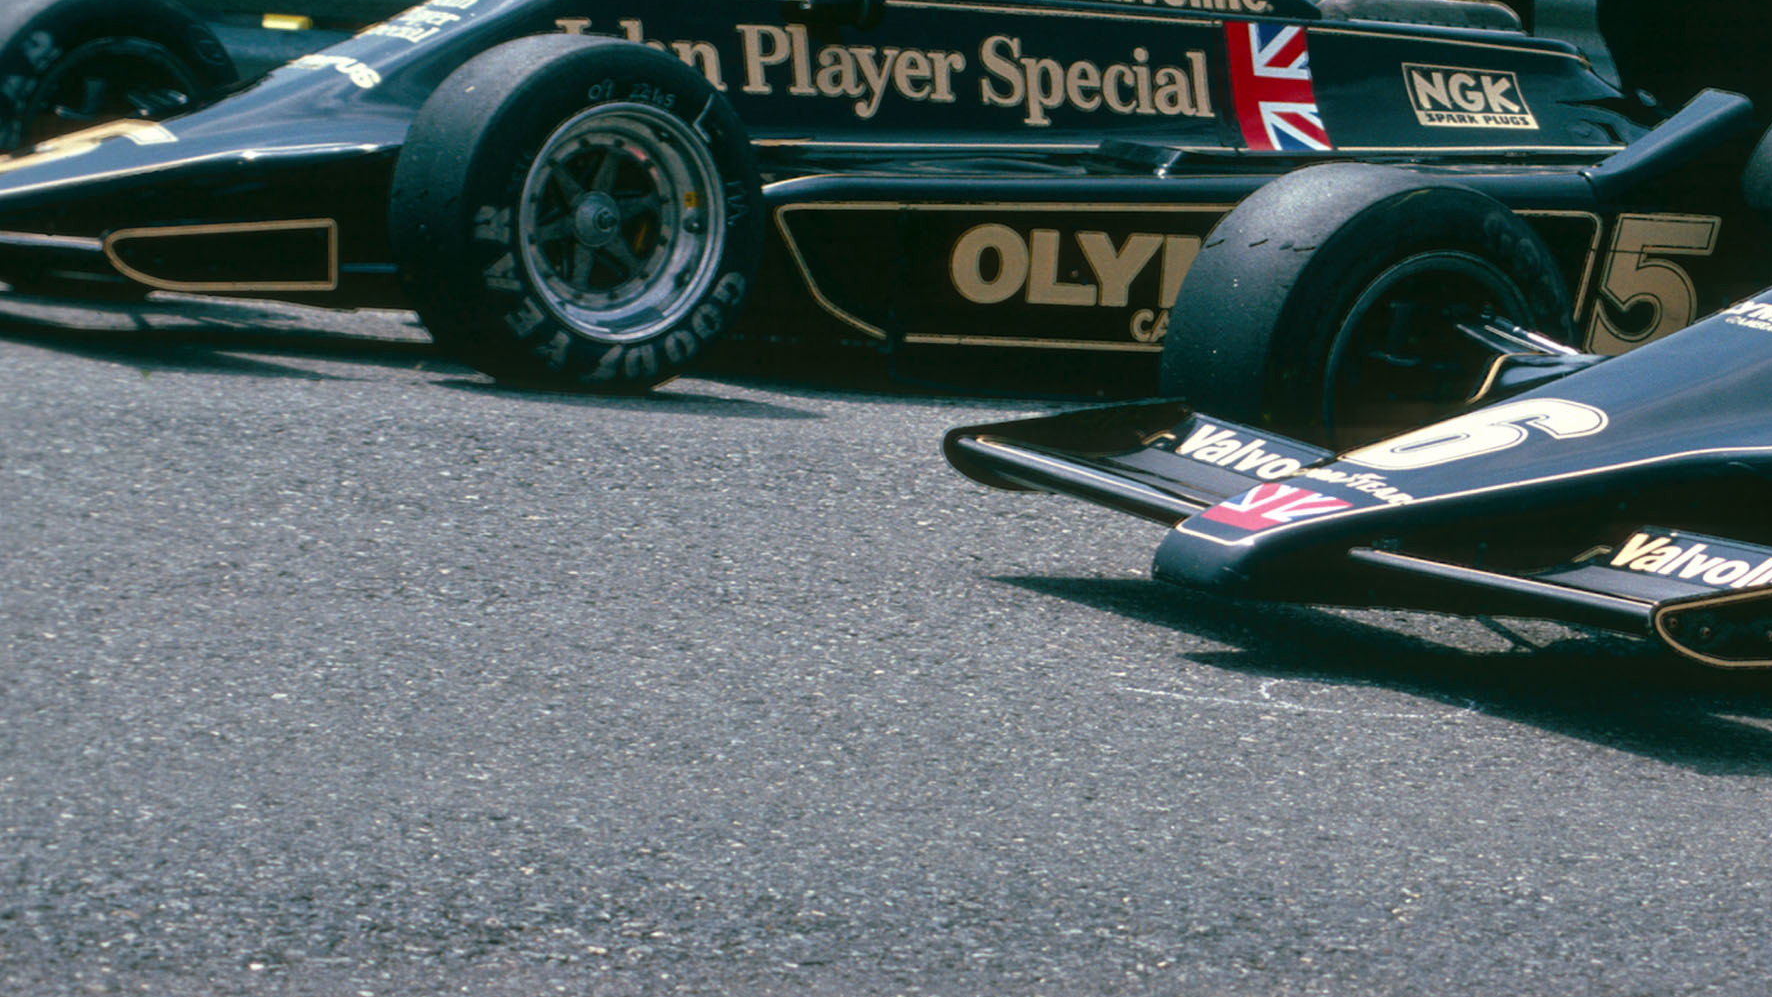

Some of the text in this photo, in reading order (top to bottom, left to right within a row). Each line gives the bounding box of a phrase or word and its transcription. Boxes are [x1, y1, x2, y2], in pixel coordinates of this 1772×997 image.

[735, 23, 966, 119] Player
[980, 33, 1215, 126] Special
[1411, 70, 1520, 113] NGK
[1426, 113, 1530, 126] SPARK PLUGS
[1583, 213, 1722, 355] 5
[1337, 397, 1609, 471] 6
